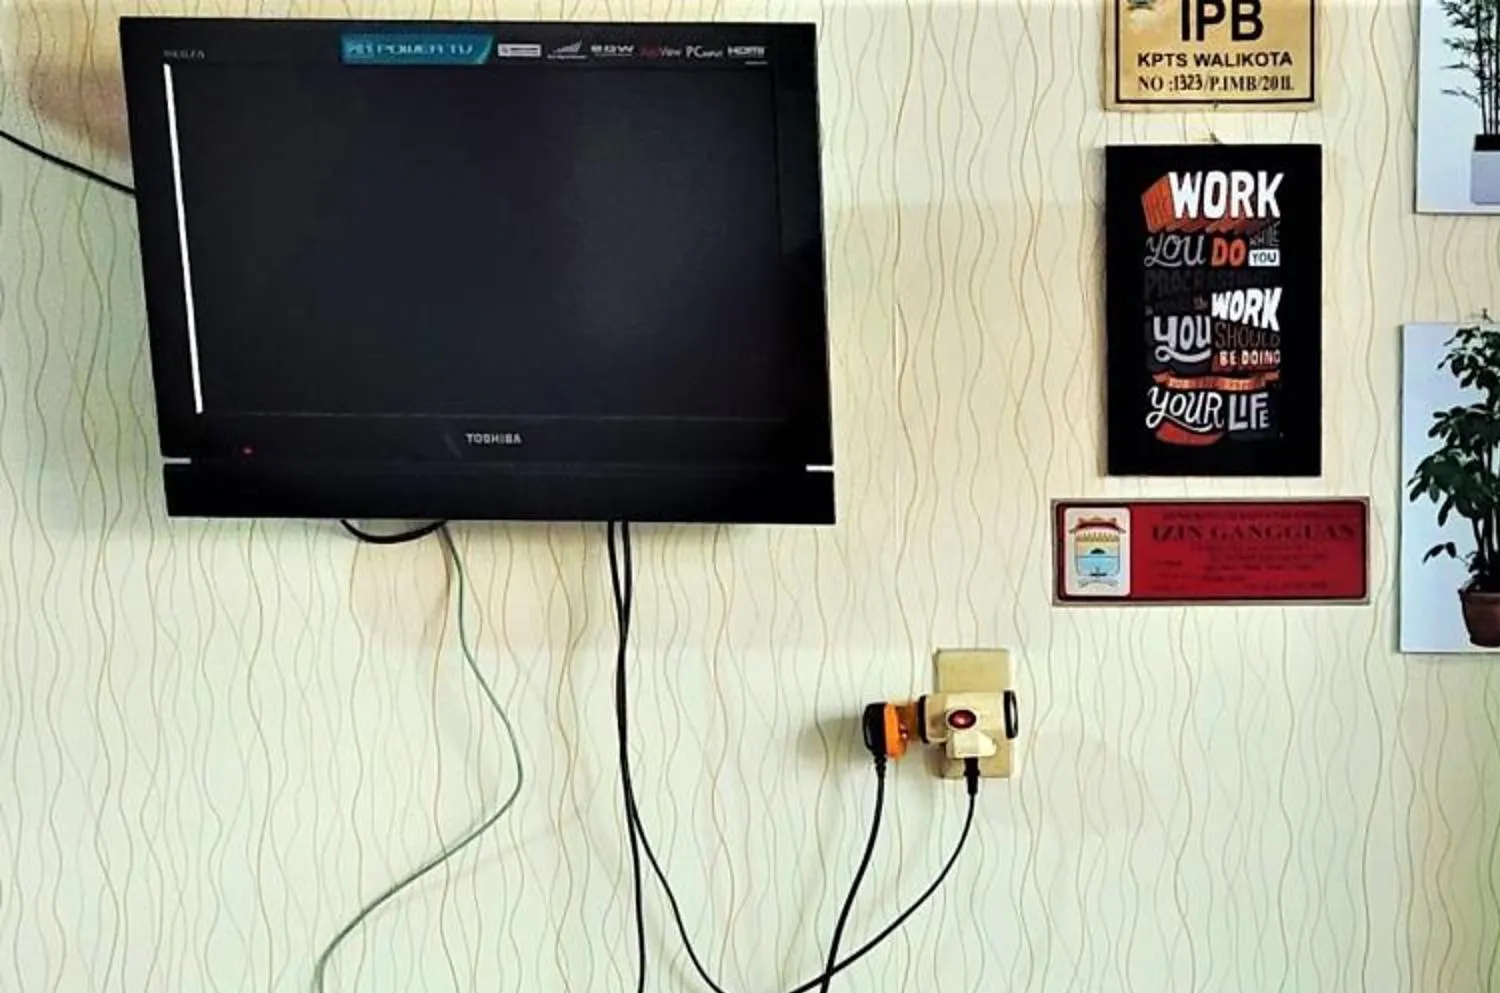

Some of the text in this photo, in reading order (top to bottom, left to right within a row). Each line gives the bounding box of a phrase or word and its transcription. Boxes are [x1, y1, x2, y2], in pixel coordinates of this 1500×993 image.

[1181, 0, 1264, 42] IPB
[1137, 51, 1293, 67] KPTS WALIKOTA
[1138, 75, 1164, 91] NO
[1168, 170, 1284, 219] WORK
[1211, 237, 1247, 267] DO
[1252, 253, 1277, 265] YOU
[1211, 287, 1283, 332] WORK
[1214, 321, 1281, 350] SHOULD
[1219, 349, 1281, 367] BE DOING
[1228, 391, 1271, 430] LIFE
[464, 432, 522, 446] TOSHIBA
[1152, 524, 1203, 541] IZIN
